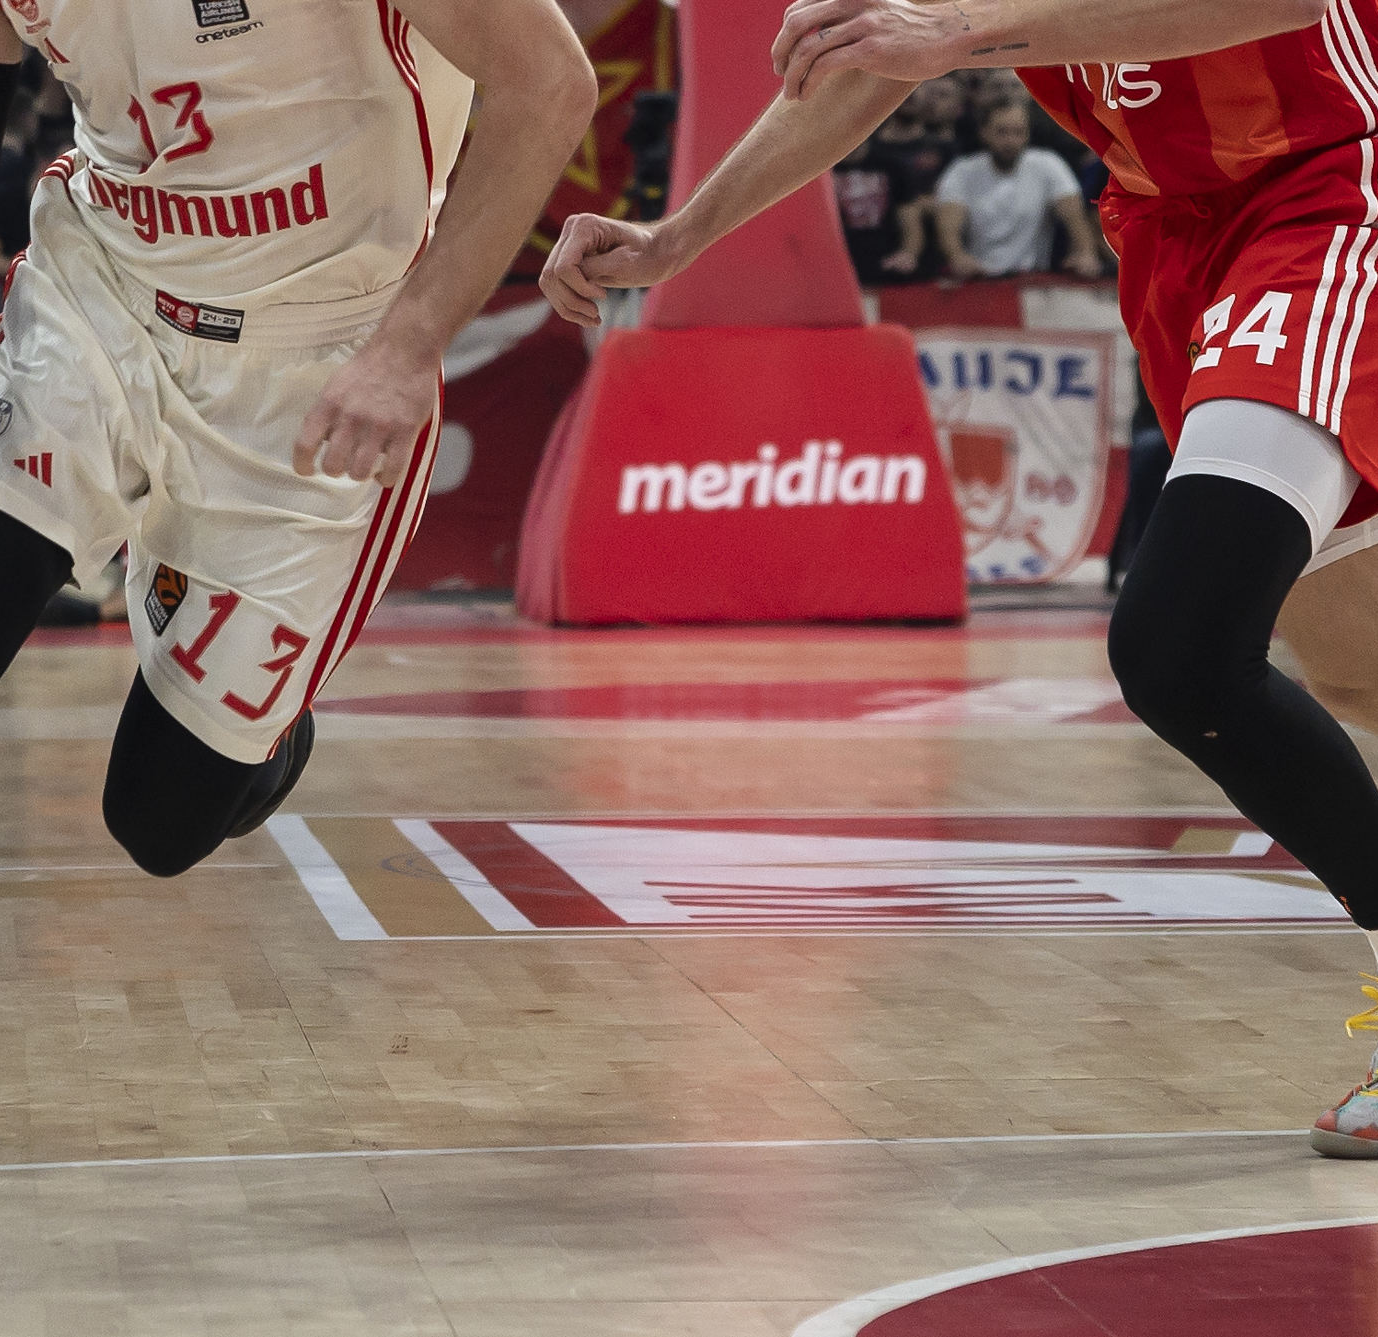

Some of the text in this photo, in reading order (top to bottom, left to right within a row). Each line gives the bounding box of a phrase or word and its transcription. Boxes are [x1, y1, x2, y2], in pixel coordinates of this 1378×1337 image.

[196, 21, 263, 43] oneteam
[127, 81, 214, 174] 13
[87, 162, 329, 244] egmund
[1191, 290, 1293, 375] 24
[618, 440, 927, 514] meridian
[169, 589, 310, 721] 13
